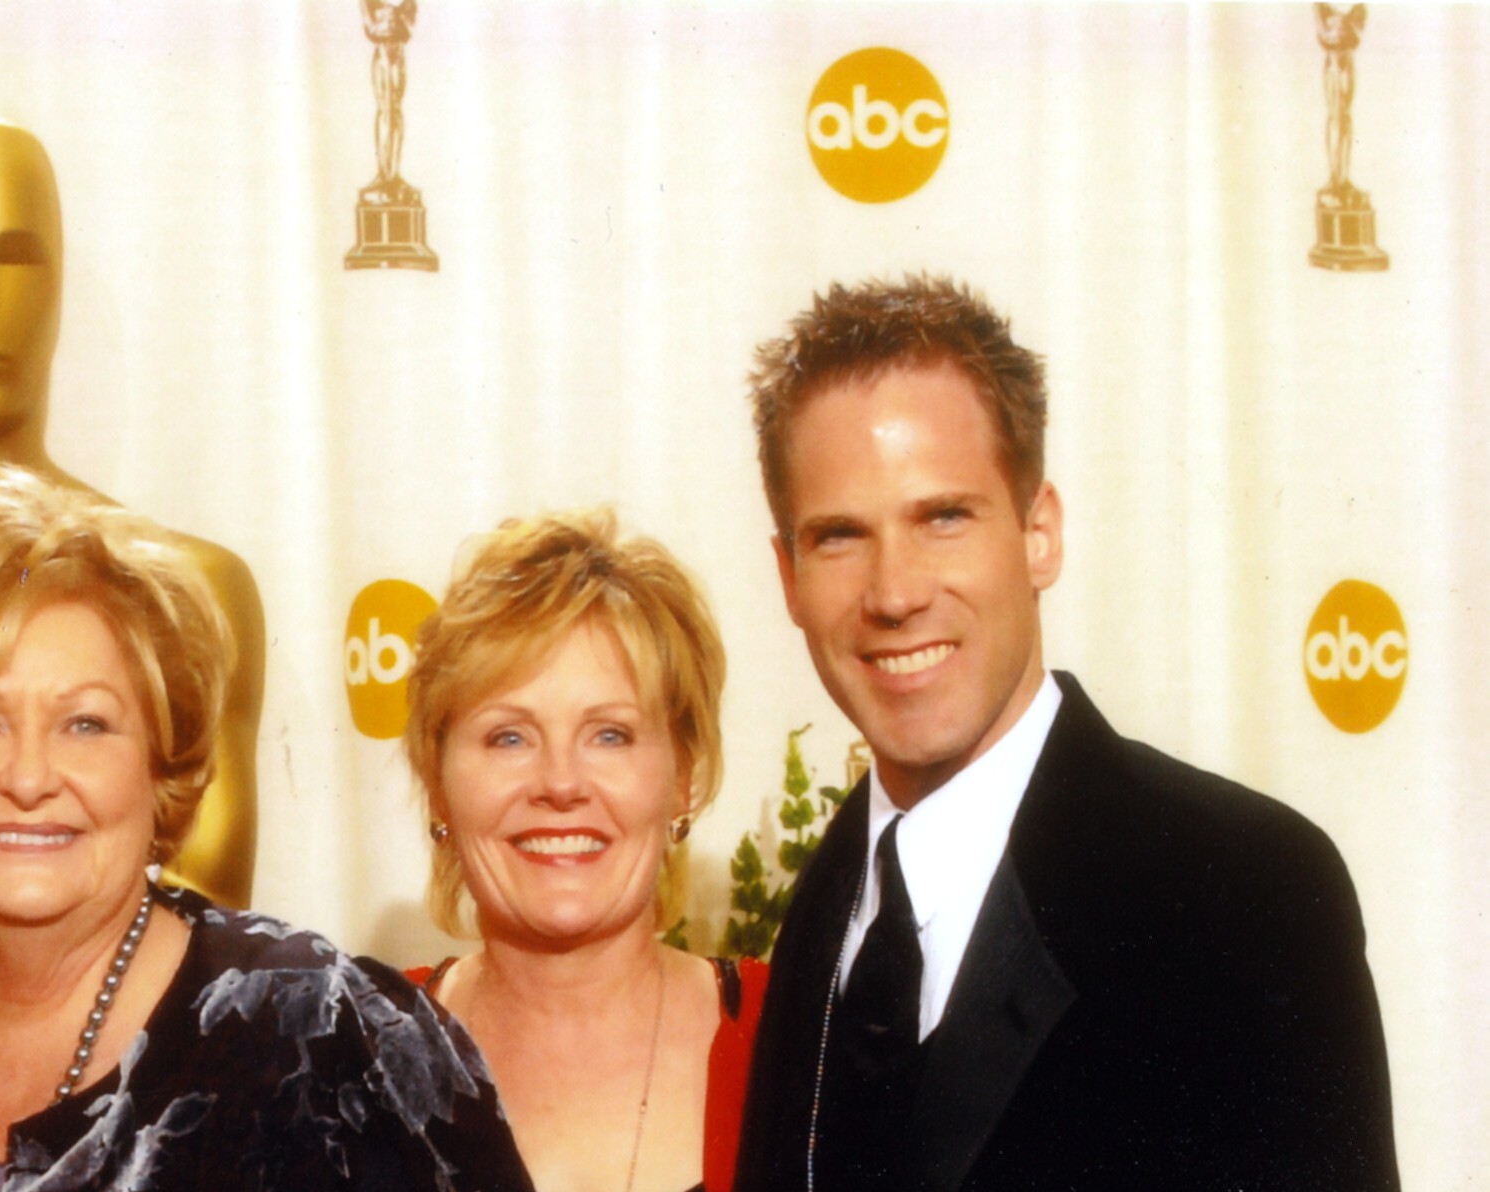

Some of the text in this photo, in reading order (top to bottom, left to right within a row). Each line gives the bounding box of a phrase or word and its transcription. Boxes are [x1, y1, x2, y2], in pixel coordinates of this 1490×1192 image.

[809, 85, 947, 149] abc
[346, 617, 416, 685] ab
[1307, 615, 1406, 681] abc
